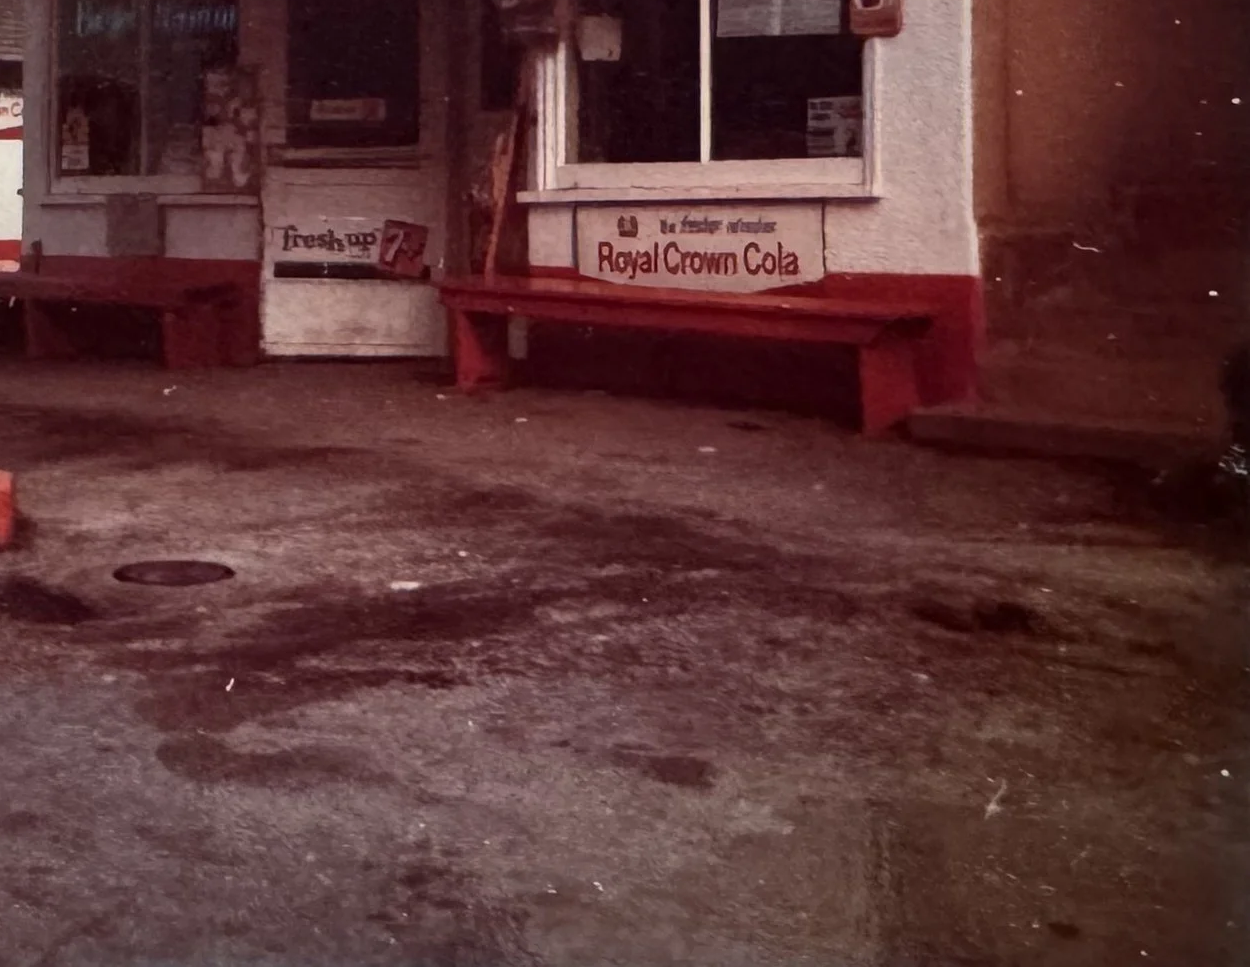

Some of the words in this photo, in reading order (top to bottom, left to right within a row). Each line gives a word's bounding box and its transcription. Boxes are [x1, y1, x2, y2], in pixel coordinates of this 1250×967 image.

[281, 224, 345, 252] fresh
[345, 232, 377, 252] up
[597, 240, 659, 280] Royal
[663, 240, 739, 276] Crown
[743, 241, 801, 276] Cola
